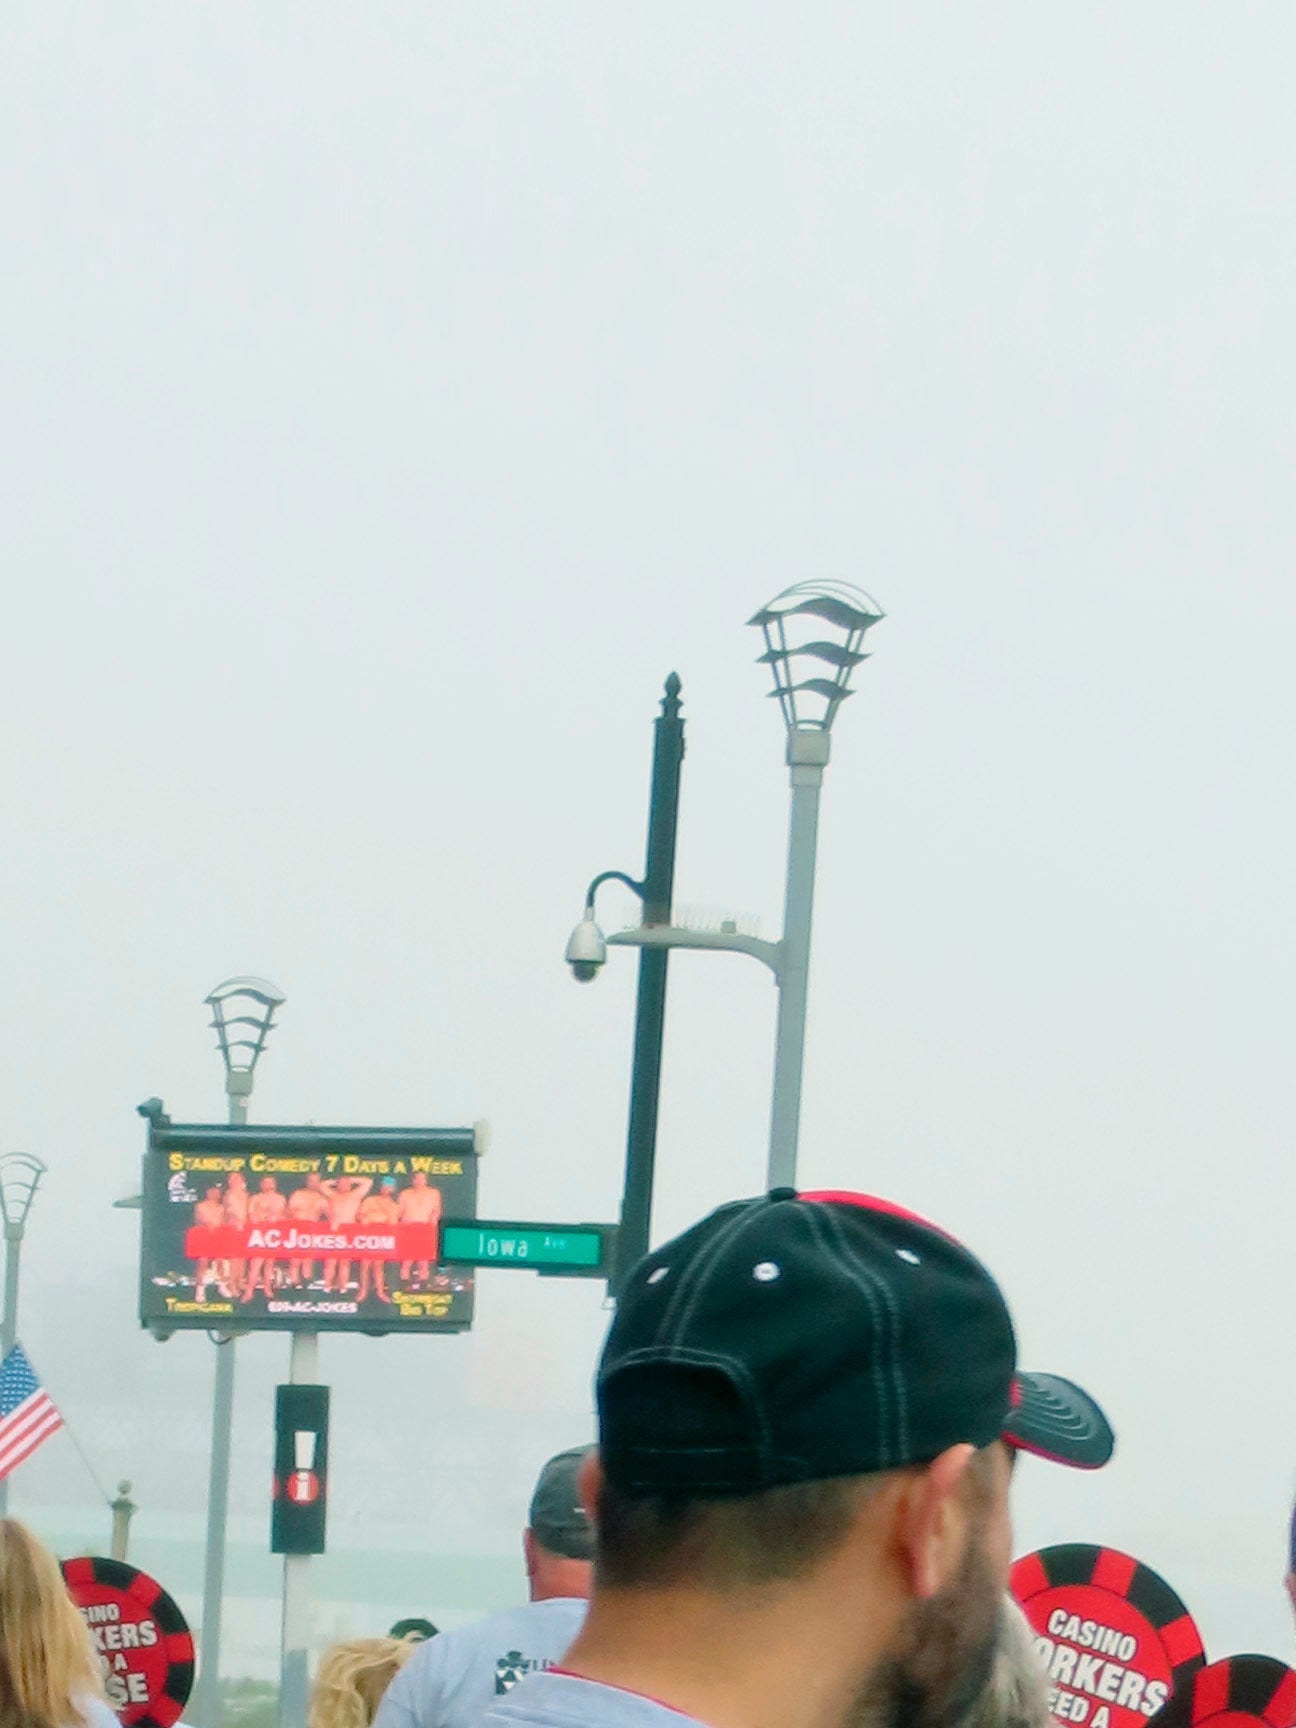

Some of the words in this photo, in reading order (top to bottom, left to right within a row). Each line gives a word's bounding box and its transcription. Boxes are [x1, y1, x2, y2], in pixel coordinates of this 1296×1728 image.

[326, 1155, 339, 1172] 7
[479, 1233, 529, 1257] Iowa
[1047, 1608, 1137, 1662] CASINO
[114, 1653, 128, 1670] A
[1035, 1636, 1168, 1716] ORKERS
[1048, 1688, 1089, 1723] EED
